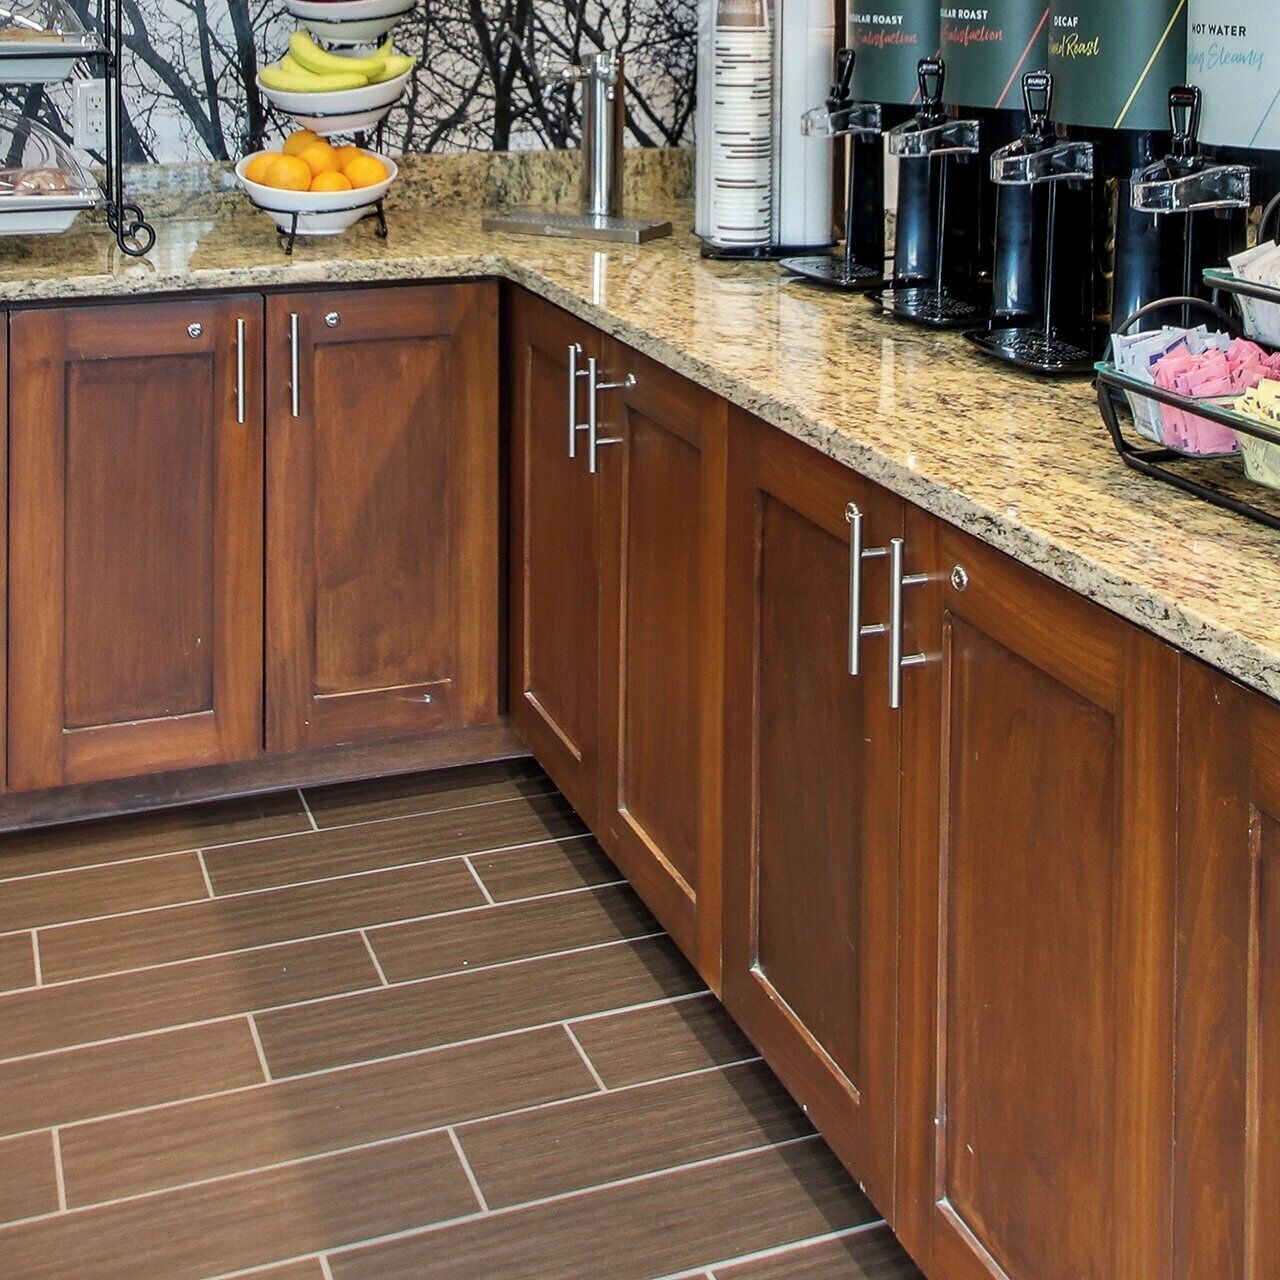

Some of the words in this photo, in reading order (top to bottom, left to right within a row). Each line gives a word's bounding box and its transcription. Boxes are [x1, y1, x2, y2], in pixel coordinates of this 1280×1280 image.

[872, 14, 904, 25] ROAST
[958, 9, 988, 20] ROAST
[1053, 15, 1079, 27] DECAF
[1191, 24, 1206, 34] HOT
[1208, 24, 1247, 37] WATER
[1065, 33, 1100, 59] Roast
[1207, 42, 1266, 71] Steamy
